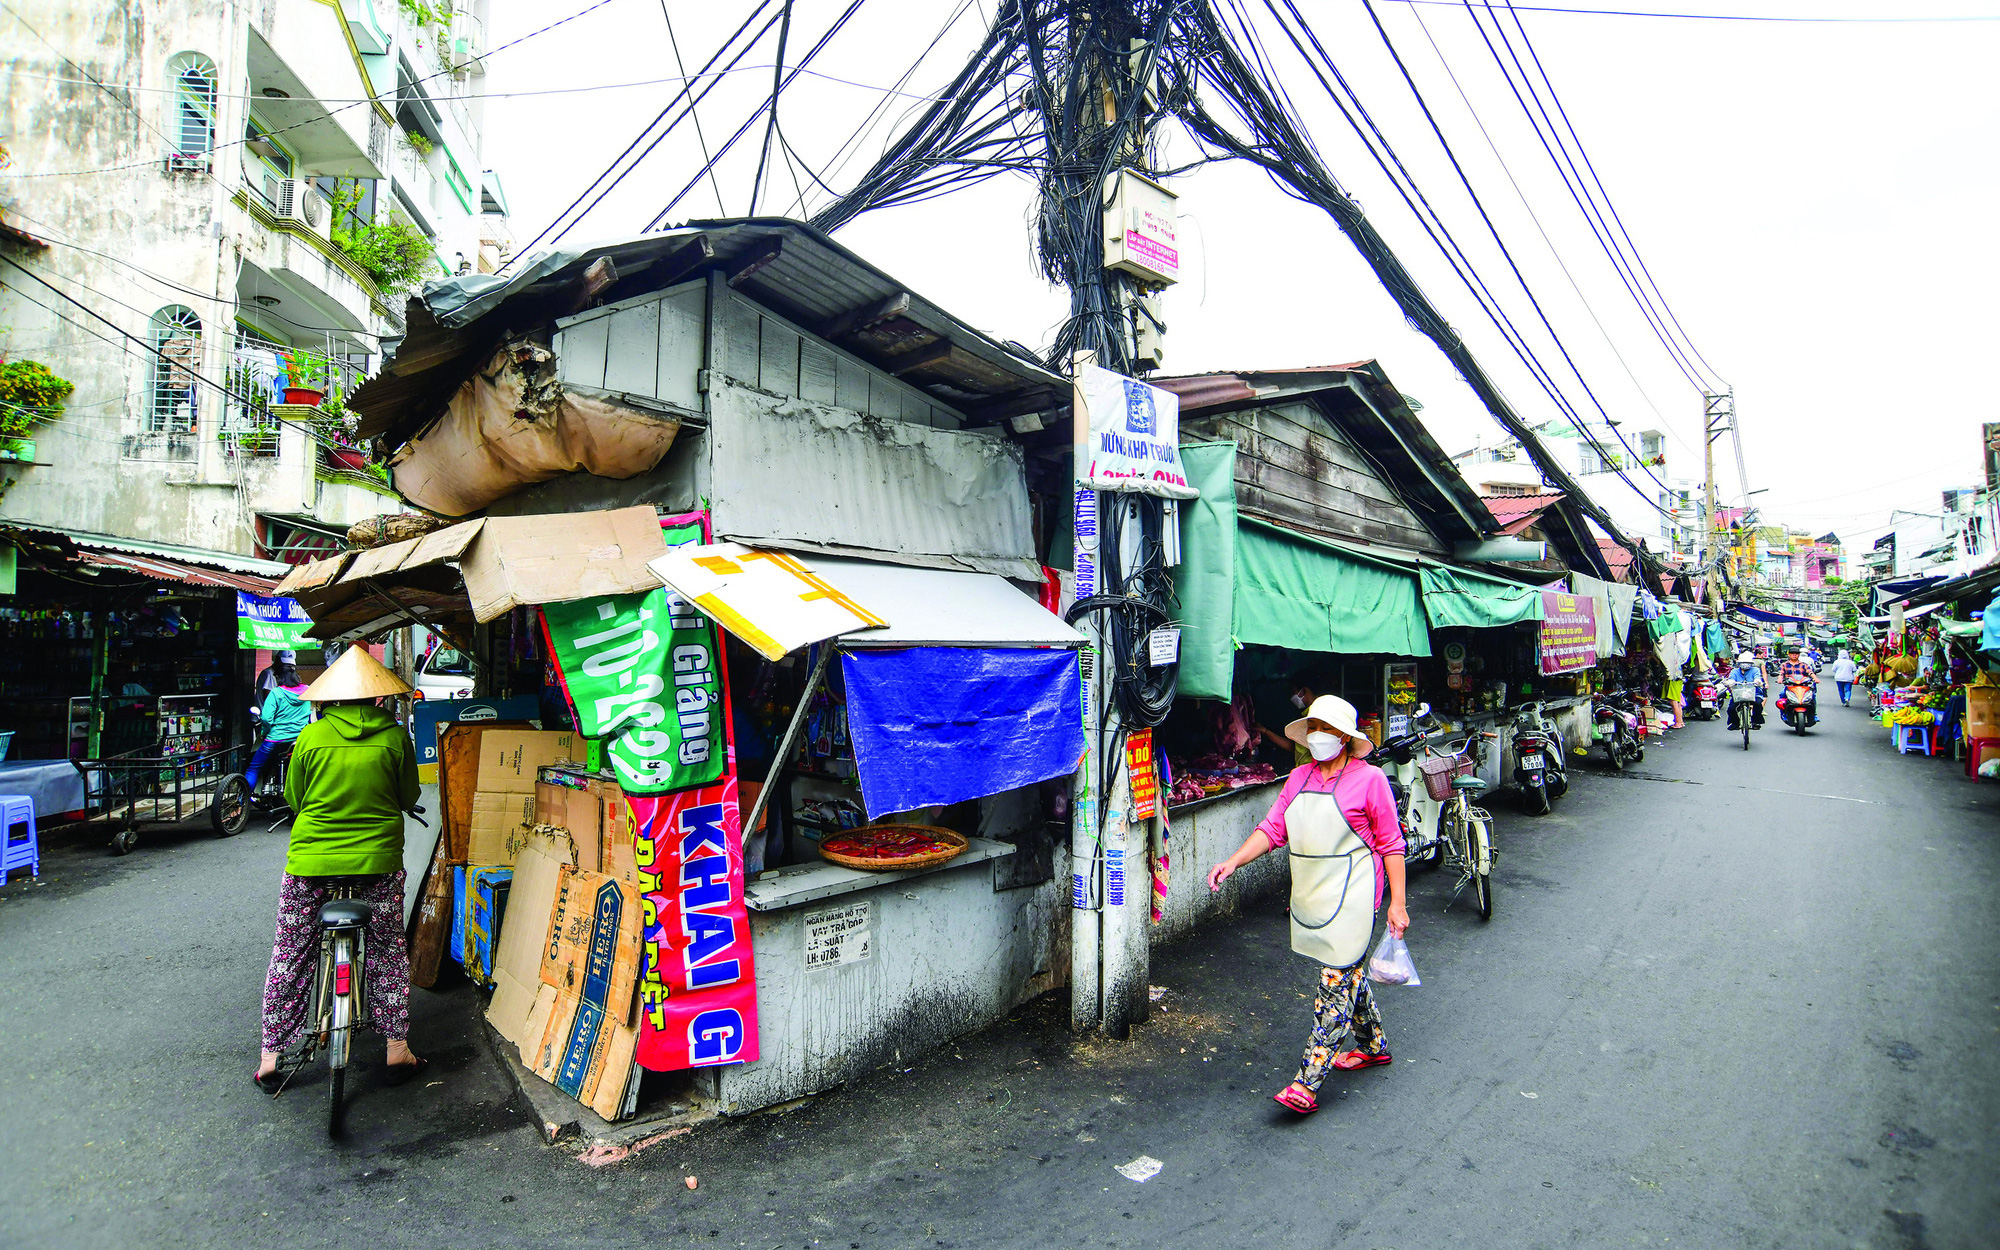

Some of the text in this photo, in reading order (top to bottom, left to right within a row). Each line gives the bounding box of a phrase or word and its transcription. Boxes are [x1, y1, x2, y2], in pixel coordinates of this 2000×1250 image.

[1135, 253, 1165, 273] 18008168
[1145, 239, 1177, 260] INTERNET
[259, 601, 282, 618] THUỐC
[672, 644, 719, 767] Giảng
[549, 886, 570, 961] HERO
[591, 896, 612, 978] HERO
[601, 912, 615, 967] FILTER KINGS
[677, 801, 745, 1068] KHAI G
[824, 933, 845, 947] SUẤT
[807, 952, 819, 965] LH:
[566, 1009, 593, 1081] HERO
